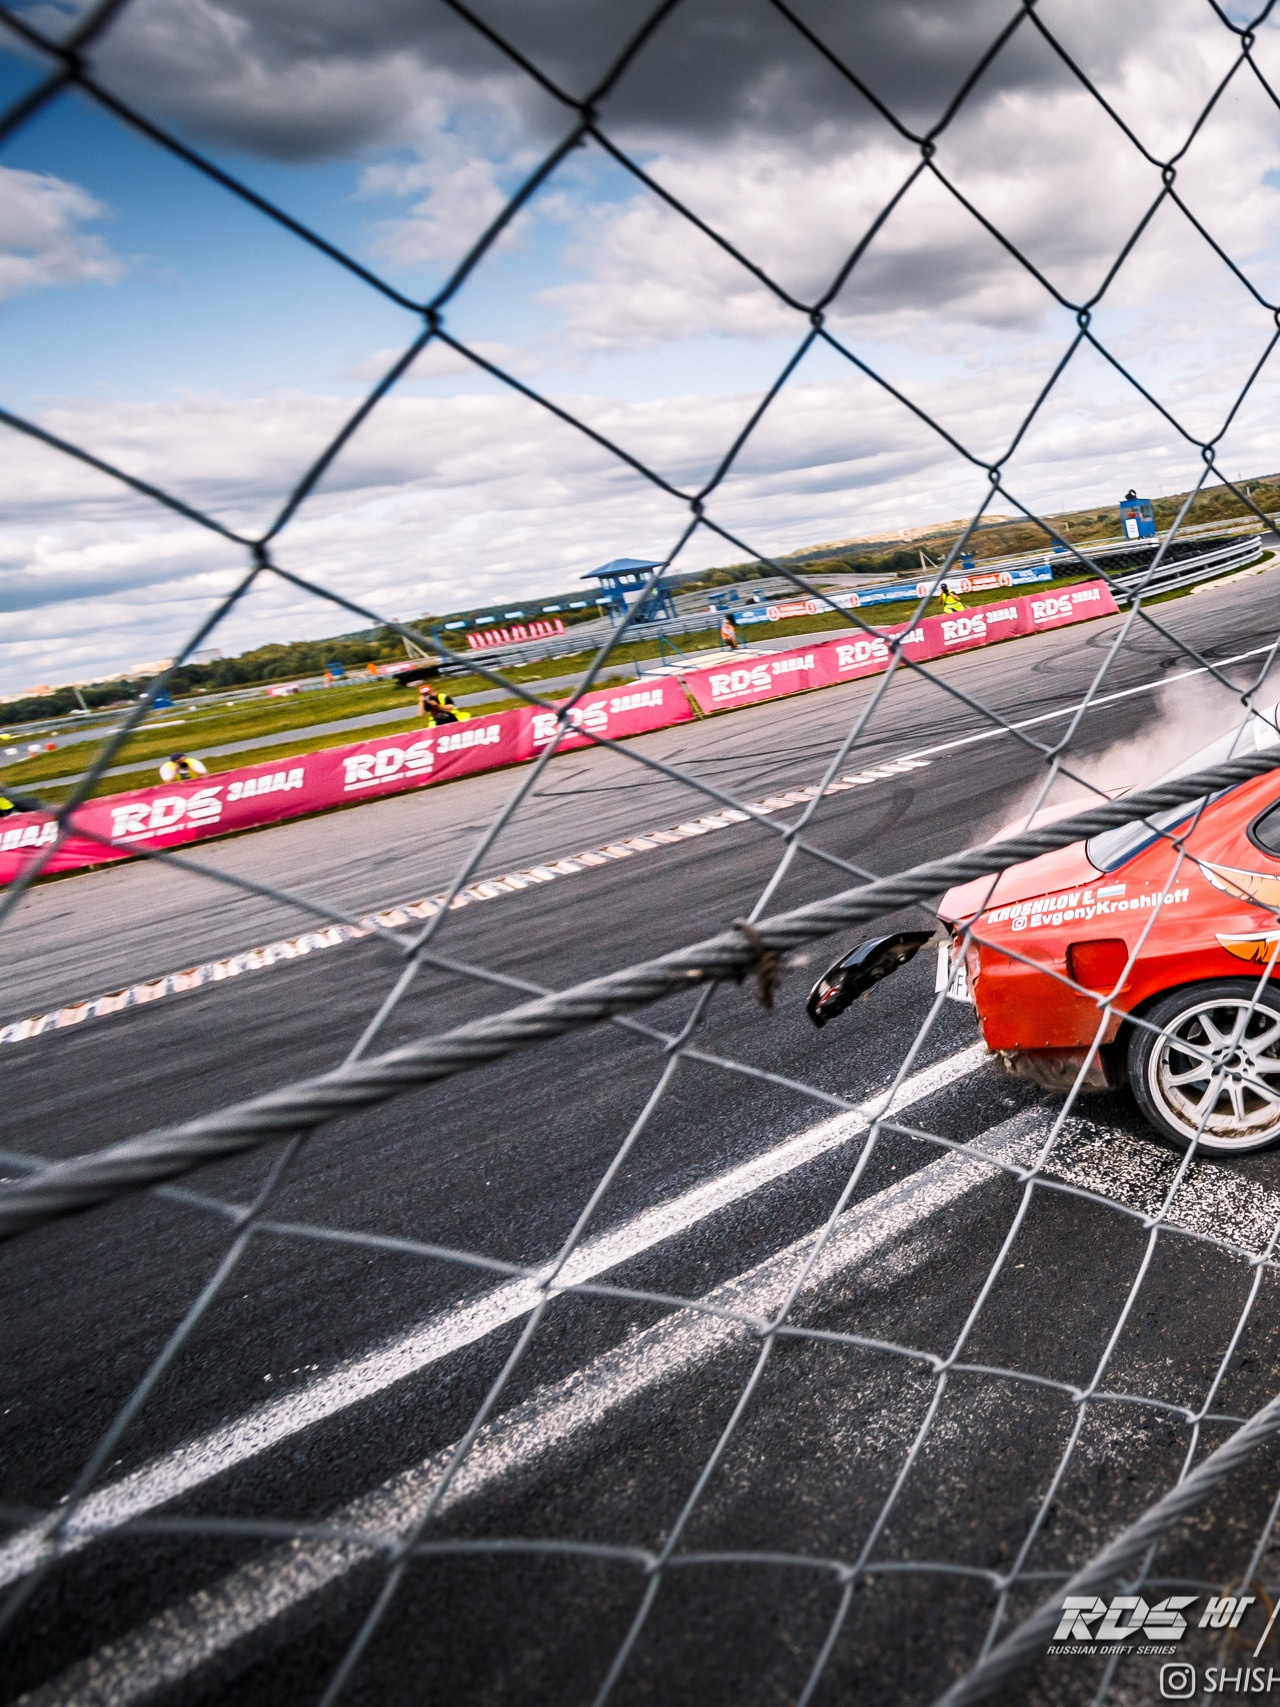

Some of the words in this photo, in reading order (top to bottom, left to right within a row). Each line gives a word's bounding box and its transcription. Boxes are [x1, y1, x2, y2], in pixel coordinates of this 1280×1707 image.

[1031, 594, 1073, 619] RDS
[941, 614, 987, 640] RDS
[836, 638, 888, 666] RDS
[709, 664, 772, 697] RDS
[343, 740, 435, 784] RDS
[437, 724, 500, 754] ЗАПАД
[110, 786, 224, 838] RDS
[226, 768, 305, 801] ЗАПАД
[987, 891, 1081, 924] KROSHILOV
[1082, 890, 1096, 905] E.
[1030, 888, 1190, 928] EvgenyKroshiloff
